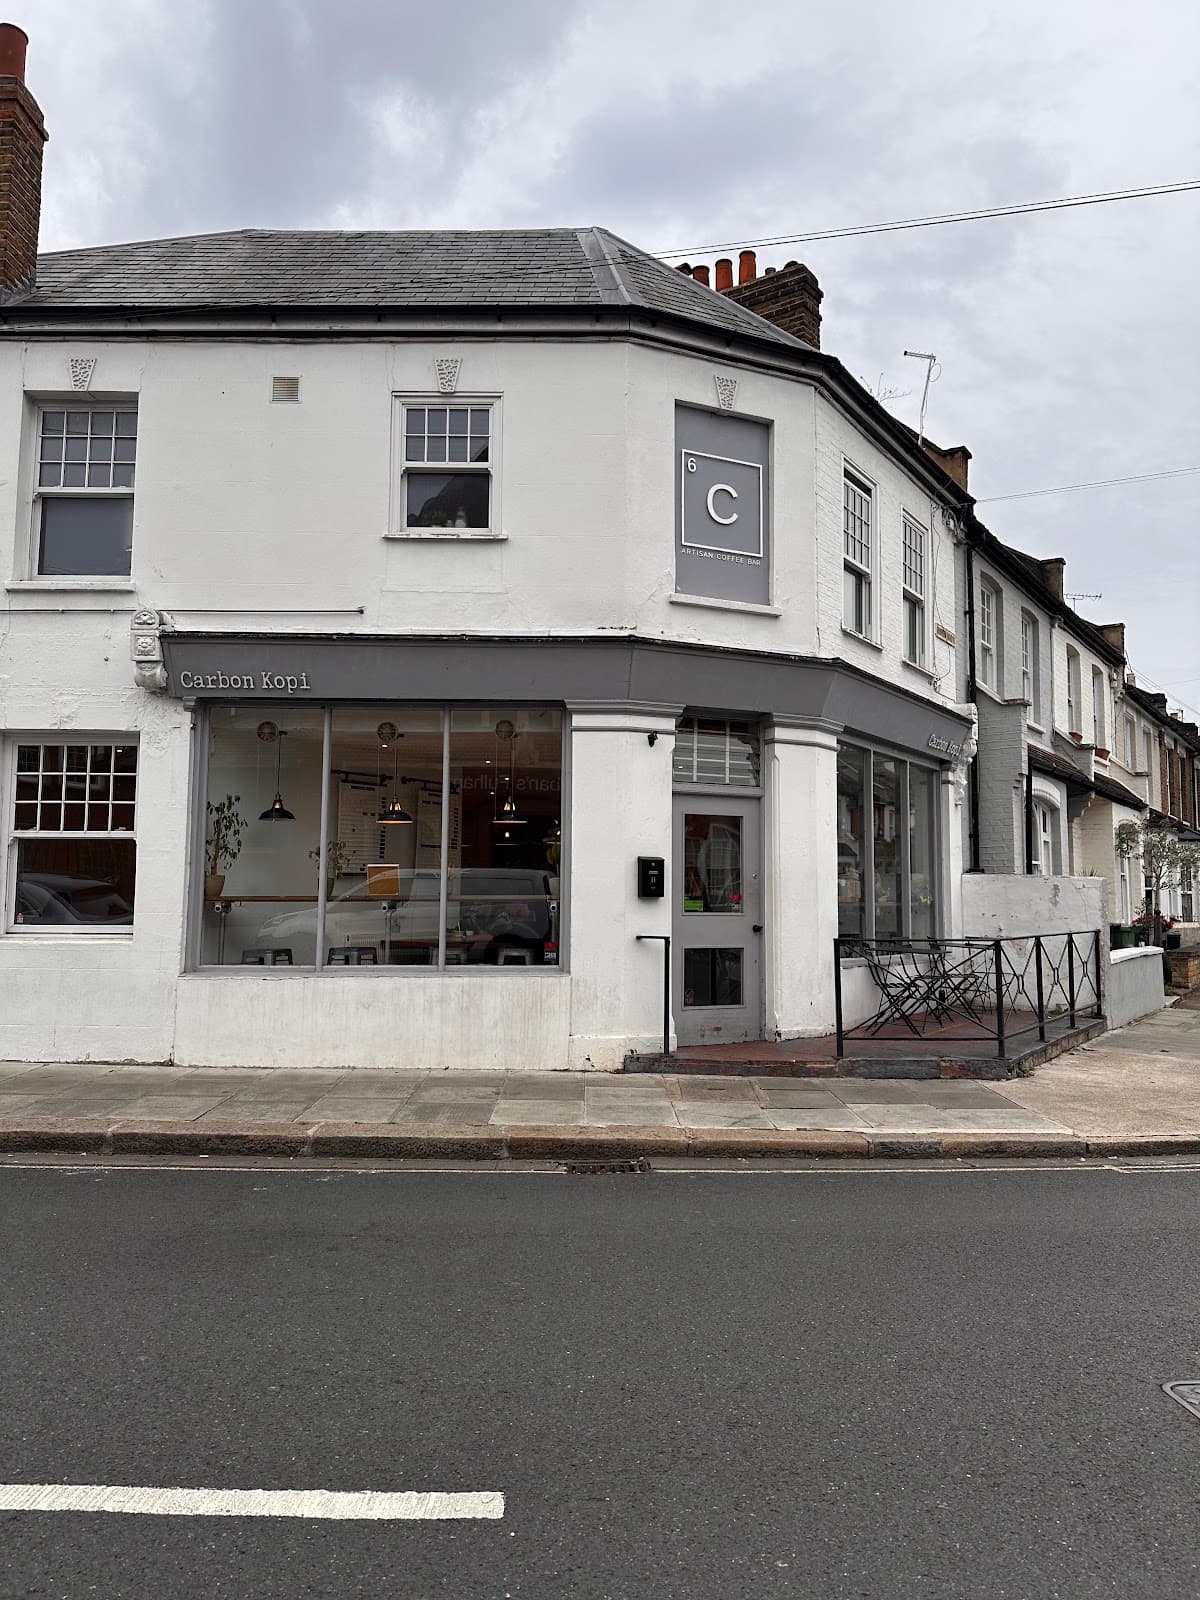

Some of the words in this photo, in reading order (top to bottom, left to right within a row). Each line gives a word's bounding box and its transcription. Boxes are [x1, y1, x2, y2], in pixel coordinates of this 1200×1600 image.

[687, 457, 697, 472] 6
[707, 483, 738, 525] C
[681, 548, 713, 558] ARTISAN
[716, 553, 744, 564] COFFEE
[747, 558, 761, 567] BAR
[180, 671, 254, 689] Carbon
[261, 671, 311, 694] Kopi
